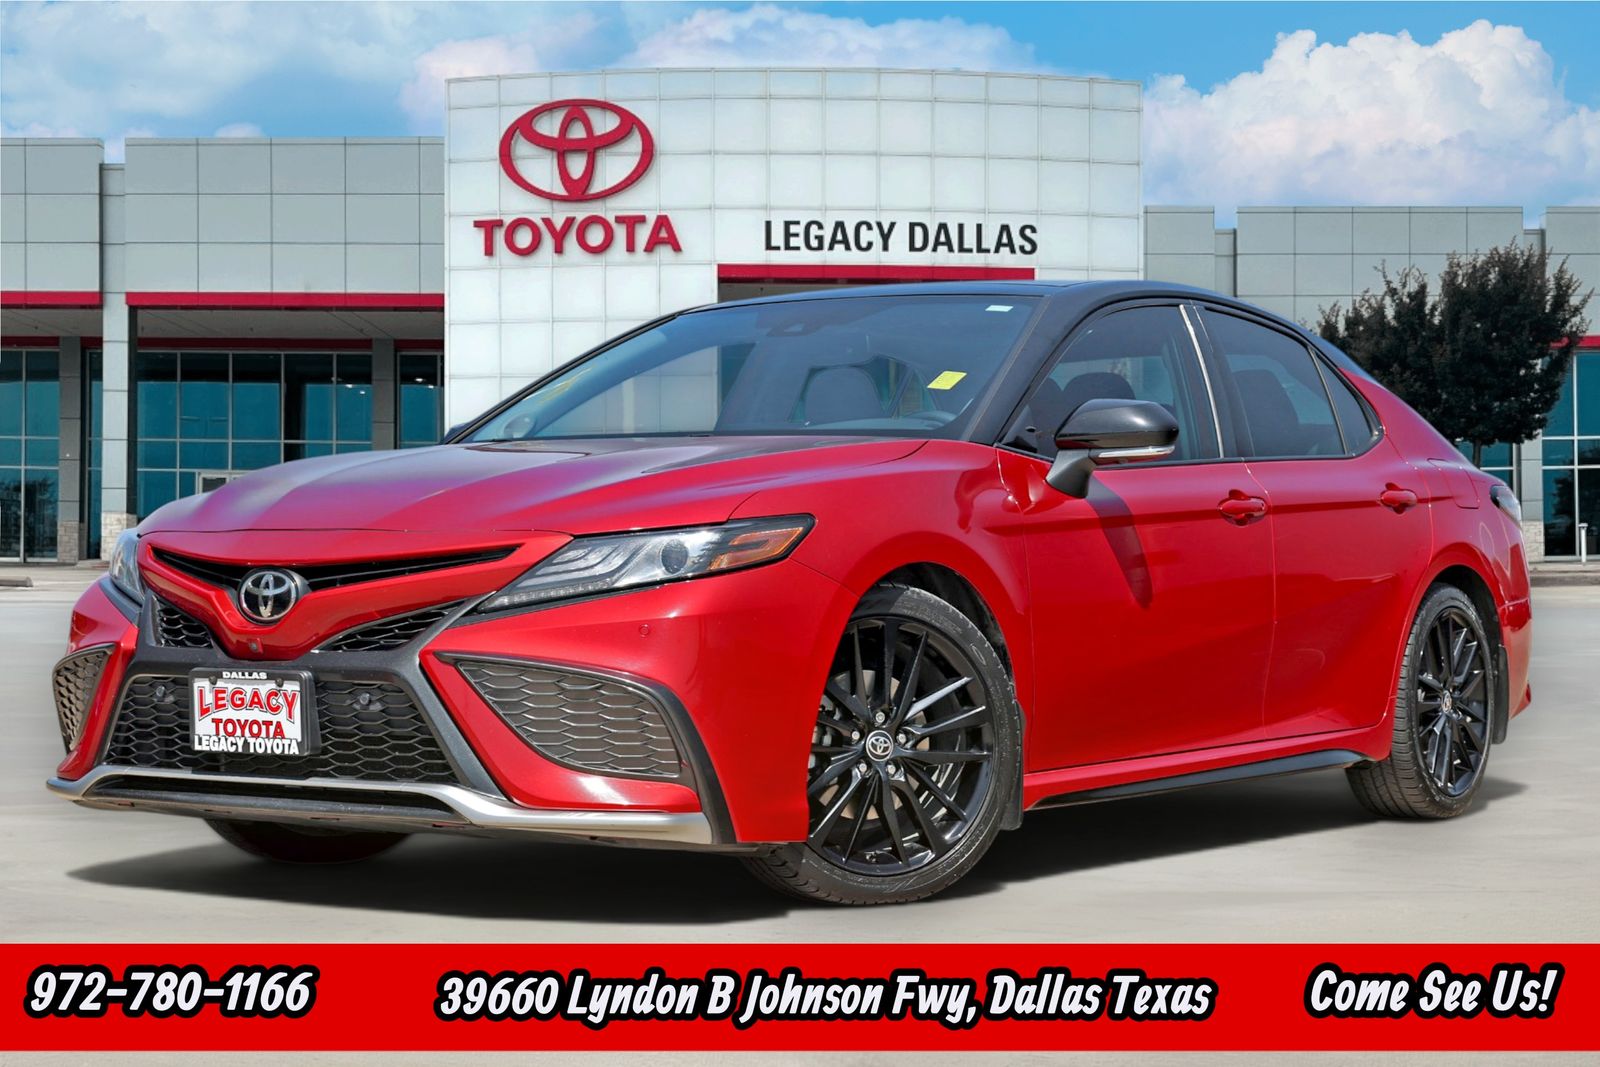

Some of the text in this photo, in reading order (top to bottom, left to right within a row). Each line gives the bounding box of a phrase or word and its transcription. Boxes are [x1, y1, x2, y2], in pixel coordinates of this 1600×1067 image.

[474, 214, 682, 256] TOYOTA
[765, 220, 1038, 255] LEGACY DALLAS
[222, 671, 268, 680] DALLAS
[197, 685, 300, 724] LEGACY
[211, 717, 286, 740] TOYOTA
[194, 734, 300, 755] LEGACY TOYOTA
